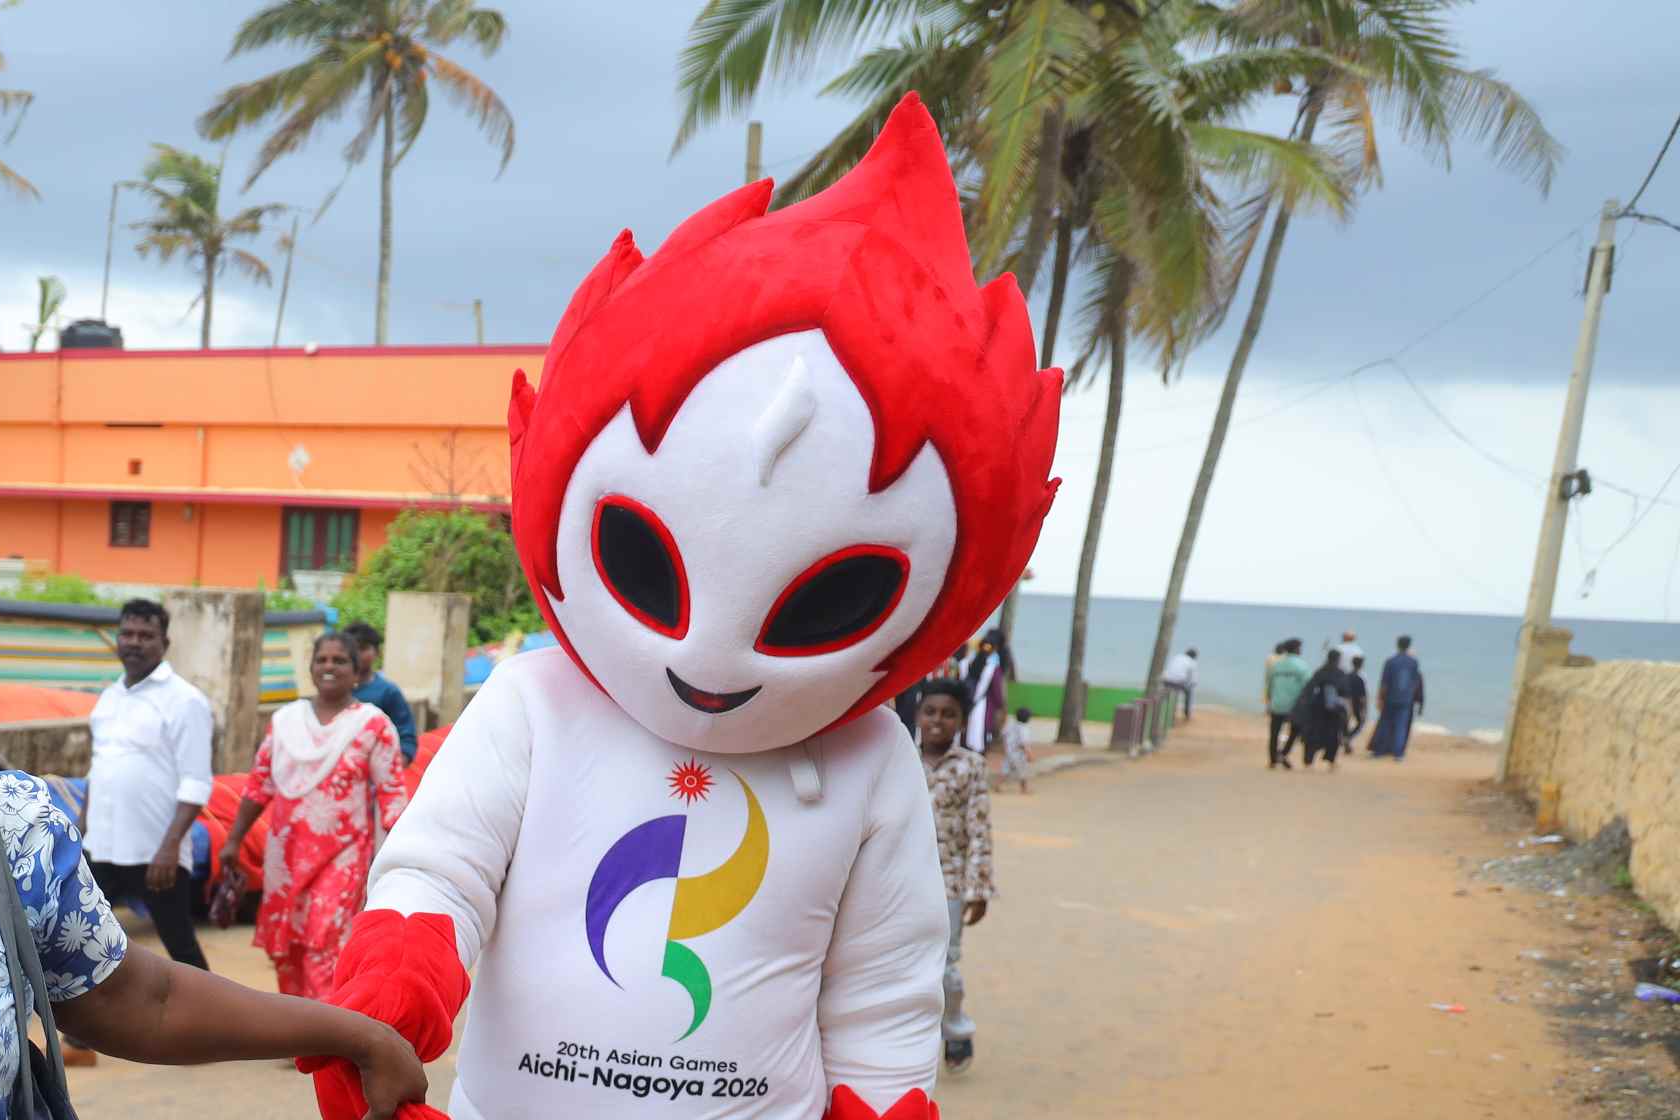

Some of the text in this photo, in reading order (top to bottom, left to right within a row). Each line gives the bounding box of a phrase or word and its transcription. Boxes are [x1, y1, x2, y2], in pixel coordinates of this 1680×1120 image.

[518, 1053, 769, 1101] Aichi-Nagoya 2026
[556, 1041, 738, 1073] 20th Asian Games
